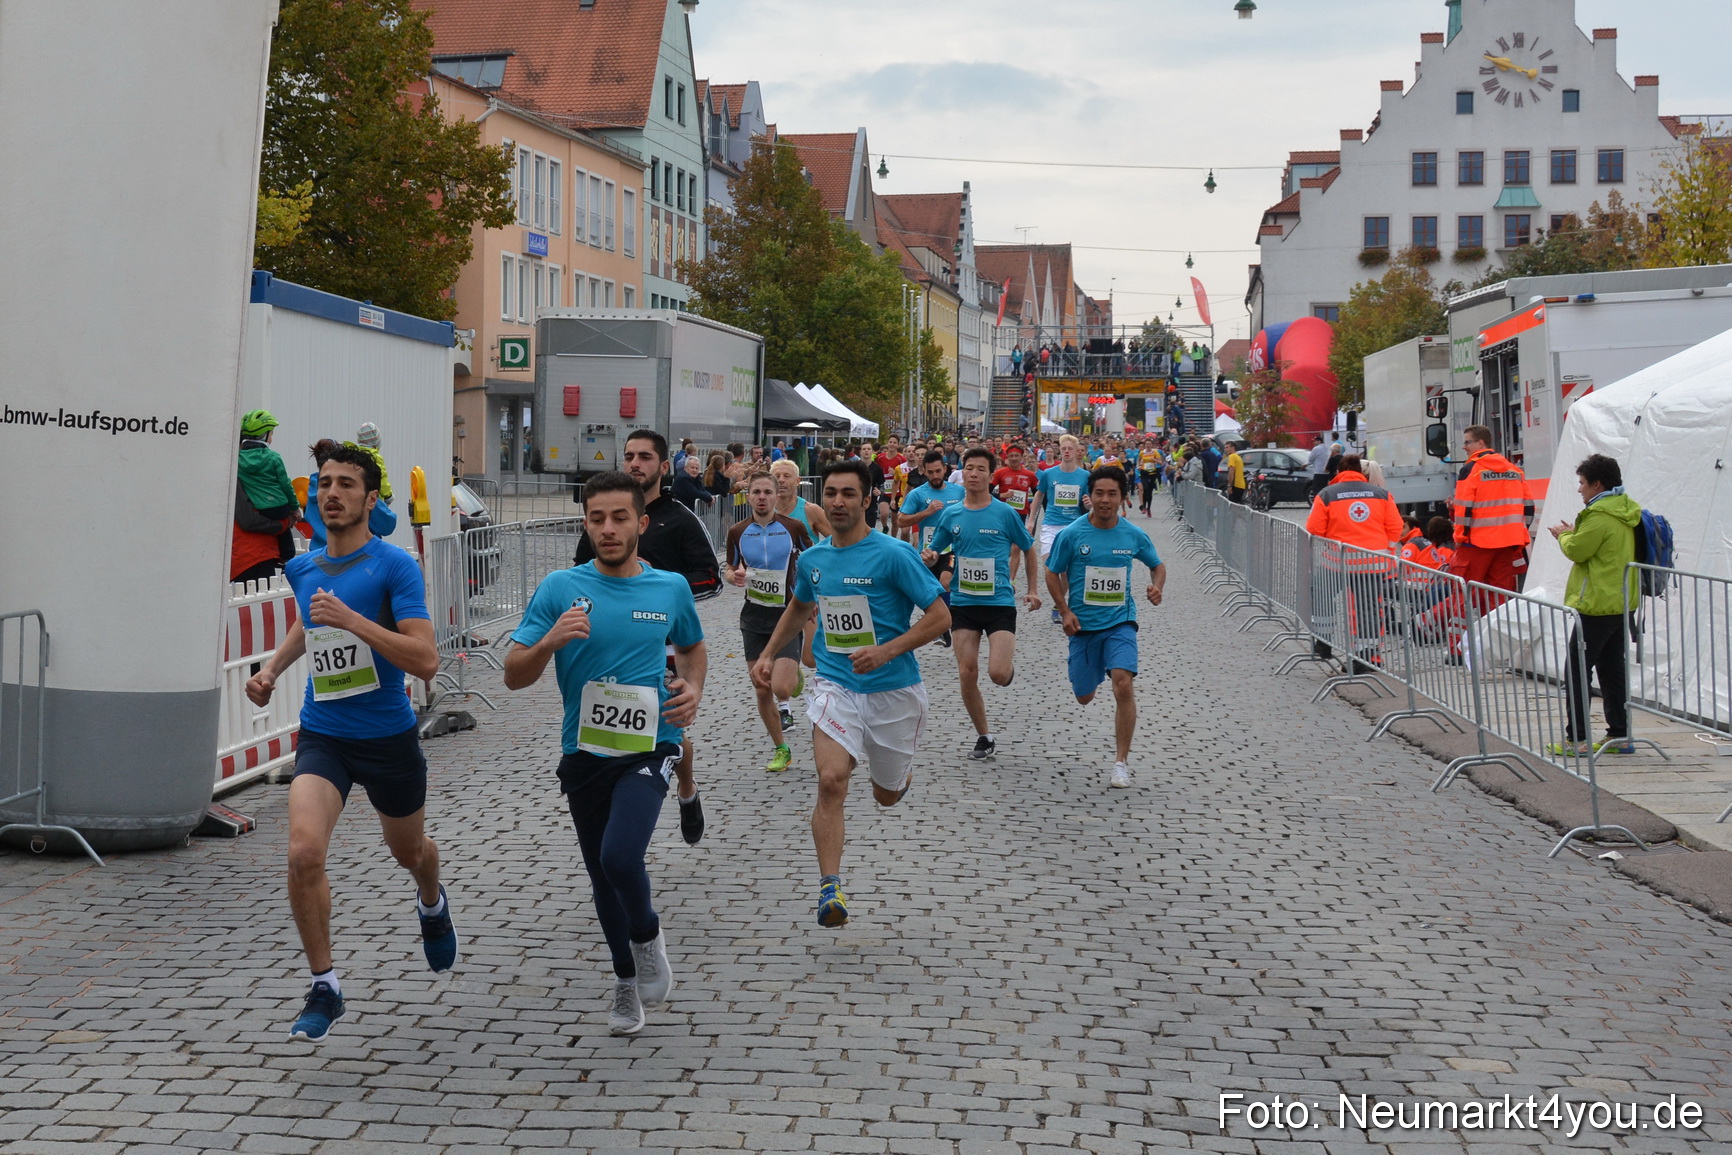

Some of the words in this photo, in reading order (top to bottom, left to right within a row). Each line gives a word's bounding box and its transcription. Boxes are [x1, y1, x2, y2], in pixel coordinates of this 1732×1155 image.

[504, 342, 526, 363] D
[1454, 338, 1474, 371] BOCK
[732, 369, 756, 405] BOCK
[1089, 382, 1117, 392] ZIEL
[1058, 491, 1076, 499] 5239
[843, 577, 873, 585] BOCK
[963, 567, 989, 581] 5195
[751, 579, 779, 594] 5206
[1091, 578, 1121, 591] 5196
[632, 611, 668, 621] BOCK
[827, 613, 863, 631] 5180
[319, 631, 343, 640] BOCK
[313, 644, 358, 673] 5187
[328, 675, 352, 687] Ahmad
[612, 691, 639, 699] BOCK
[591, 703, 647, 731] 5246
[828, 717, 846, 735] LEGEA
